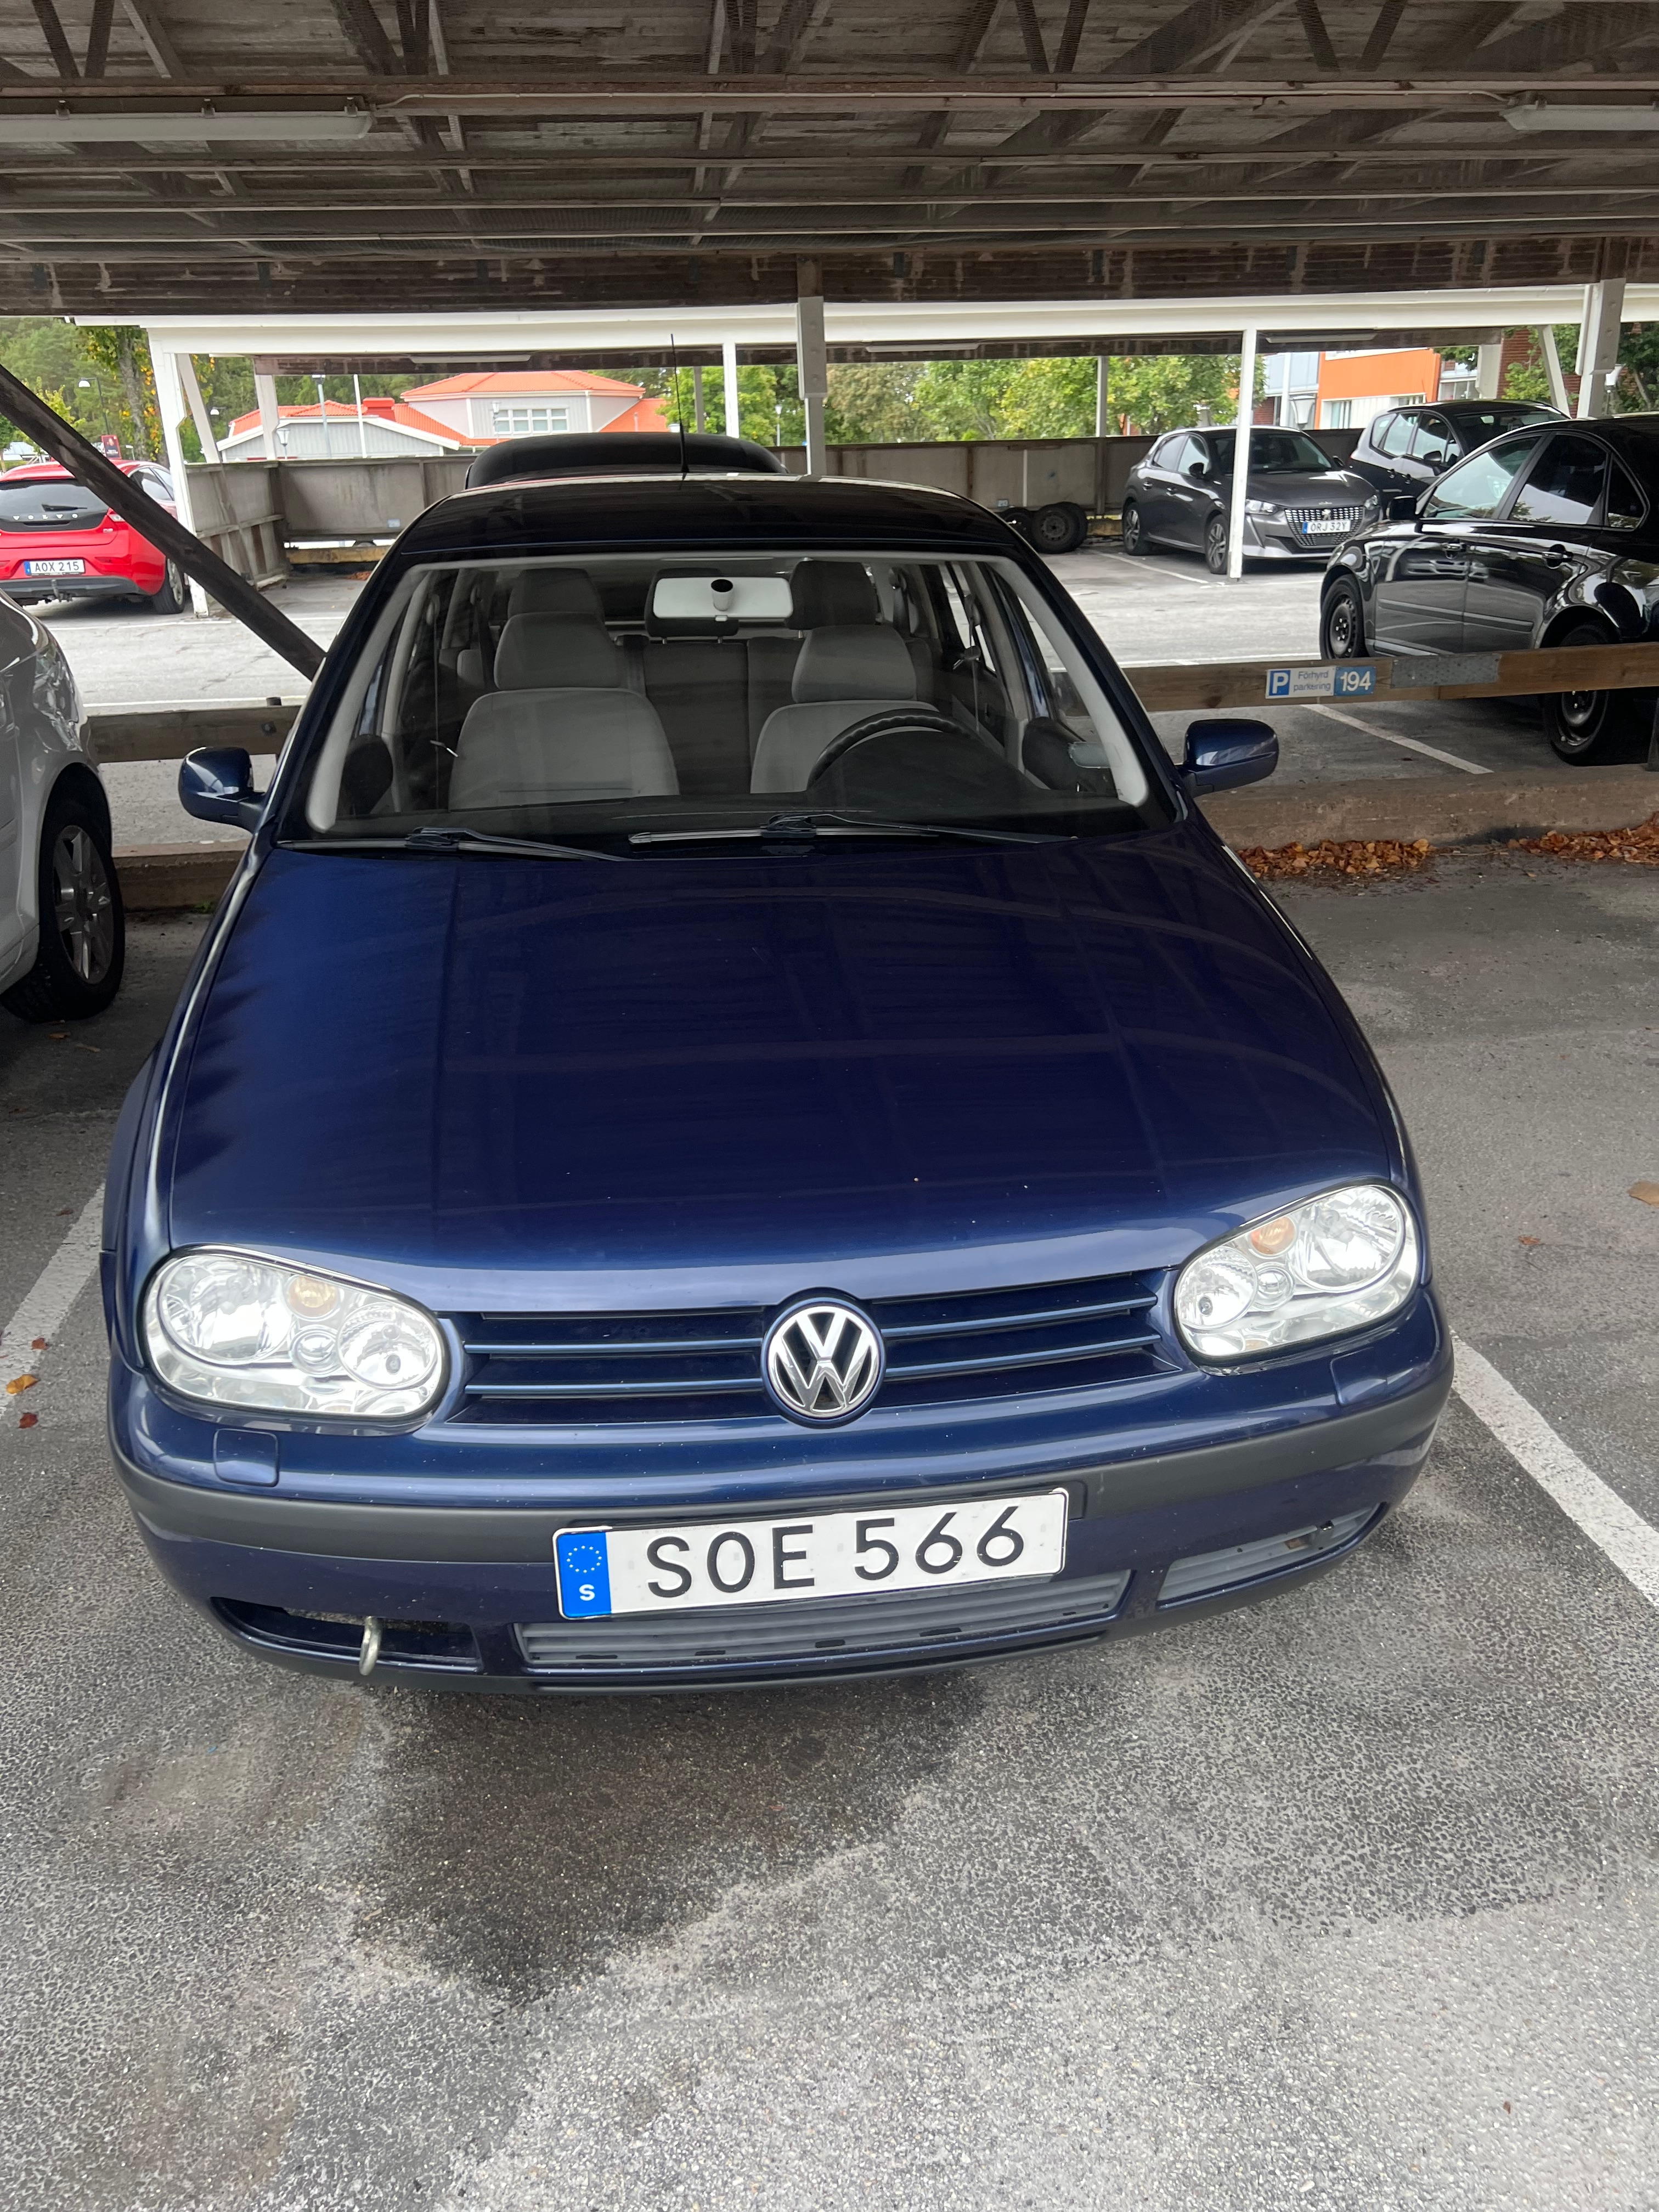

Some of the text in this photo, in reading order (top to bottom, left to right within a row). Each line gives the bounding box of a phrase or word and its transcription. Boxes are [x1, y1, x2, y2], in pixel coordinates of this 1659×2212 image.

[35, 561, 80, 572] AOX 215
[1272, 672, 1289, 694] P
[1298, 670, 1329, 679] Förhyrd
[1340, 671, 1372, 692] 194
[1294, 682, 1331, 693] parkering
[770, 1306, 878, 1418] VW
[646, 1506, 1024, 1598] SOE 566
[579, 1584, 595, 1601] S
